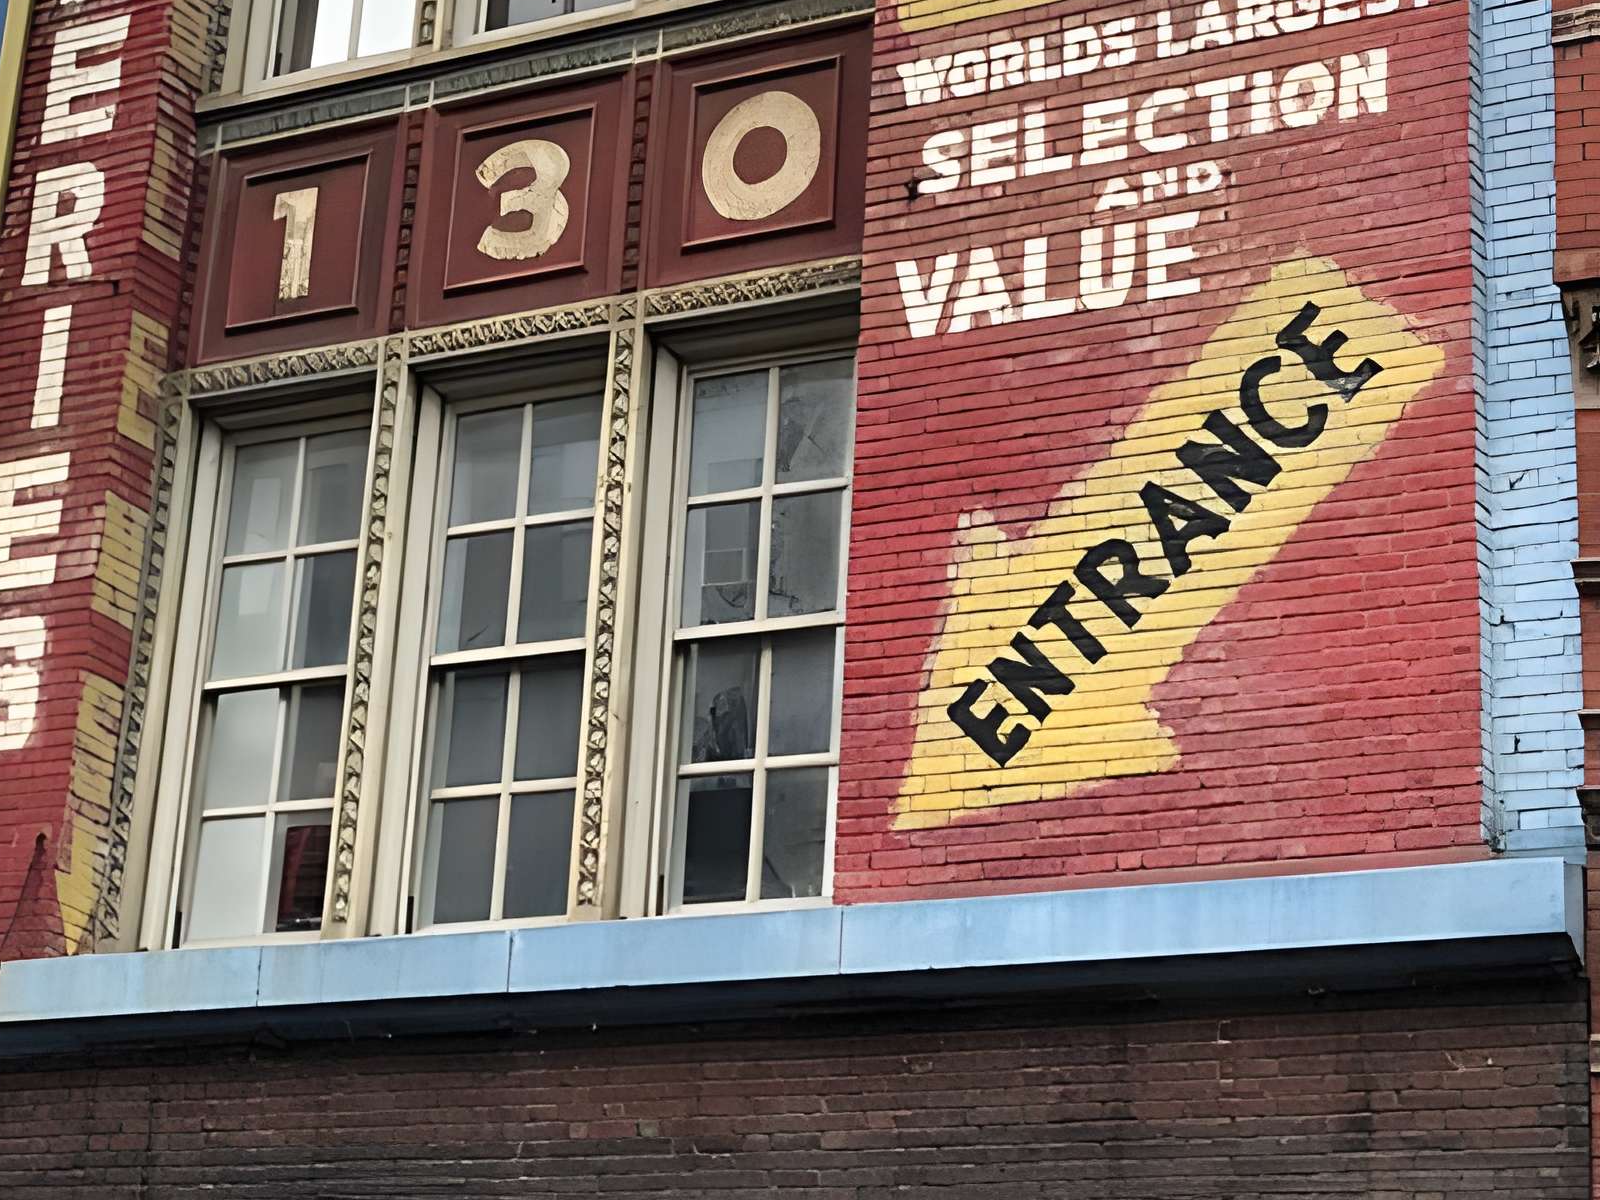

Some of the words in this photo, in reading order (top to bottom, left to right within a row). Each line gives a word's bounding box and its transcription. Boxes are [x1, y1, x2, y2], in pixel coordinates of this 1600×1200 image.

[918, 47, 1388, 194] SELECTION
[896, 210, 1202, 338] VALUE
[947, 300, 1384, 768] ENTRANCE
